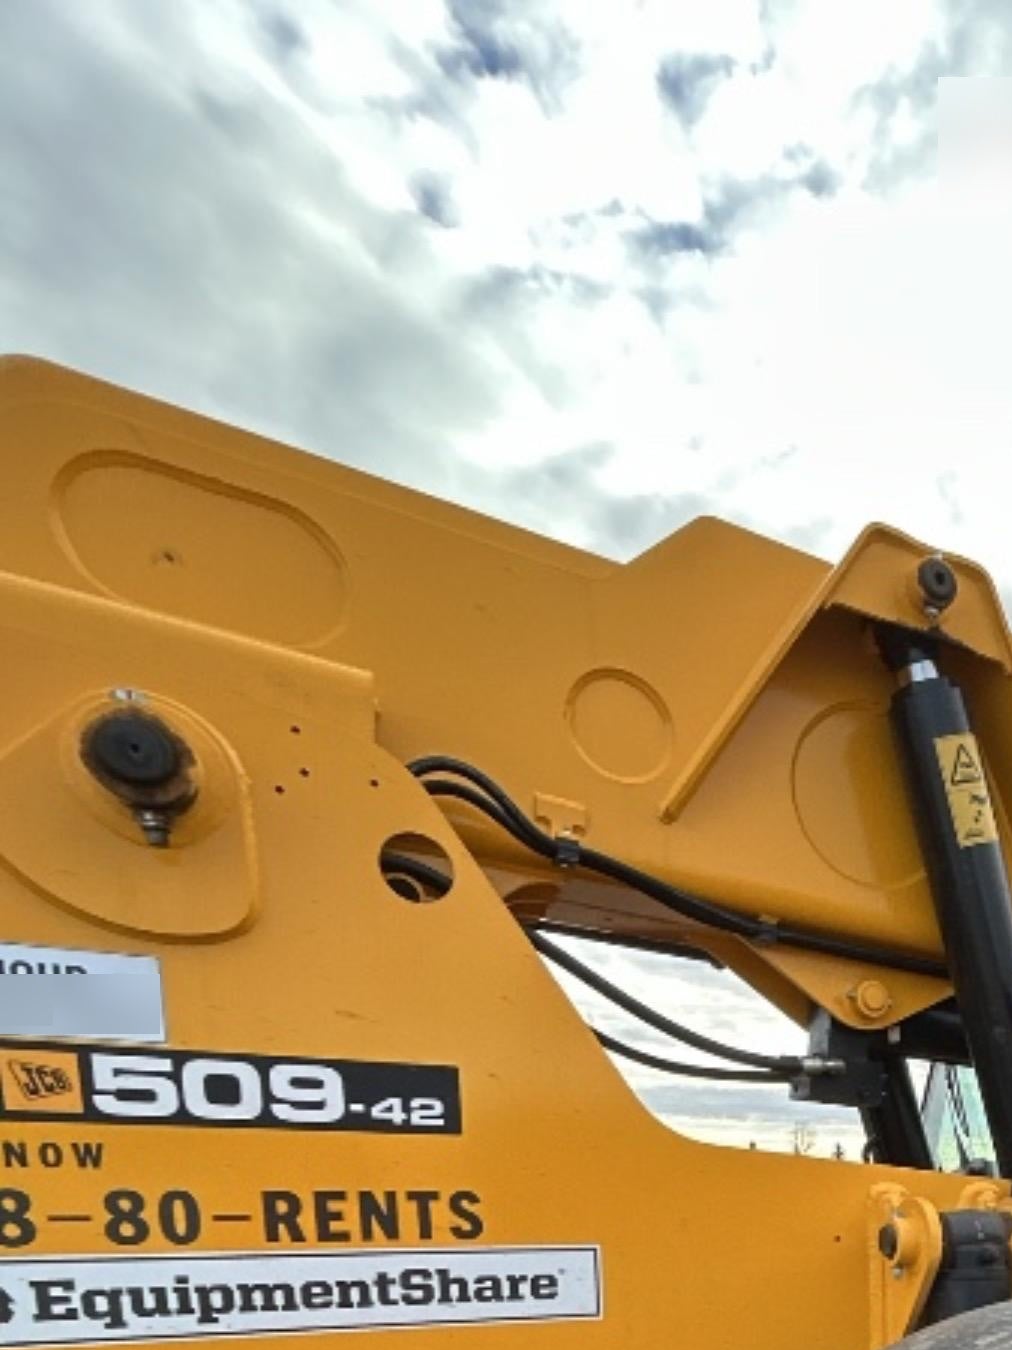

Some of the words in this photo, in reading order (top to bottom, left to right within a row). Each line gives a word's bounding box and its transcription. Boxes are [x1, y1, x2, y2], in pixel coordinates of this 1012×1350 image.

[20, 1060, 72, 1099] JCB
[91, 1052, 446, 1127] 509-42
[2, 1141, 104, 1169] NOW
[28, 1268, 560, 1329] EquipmentShare
